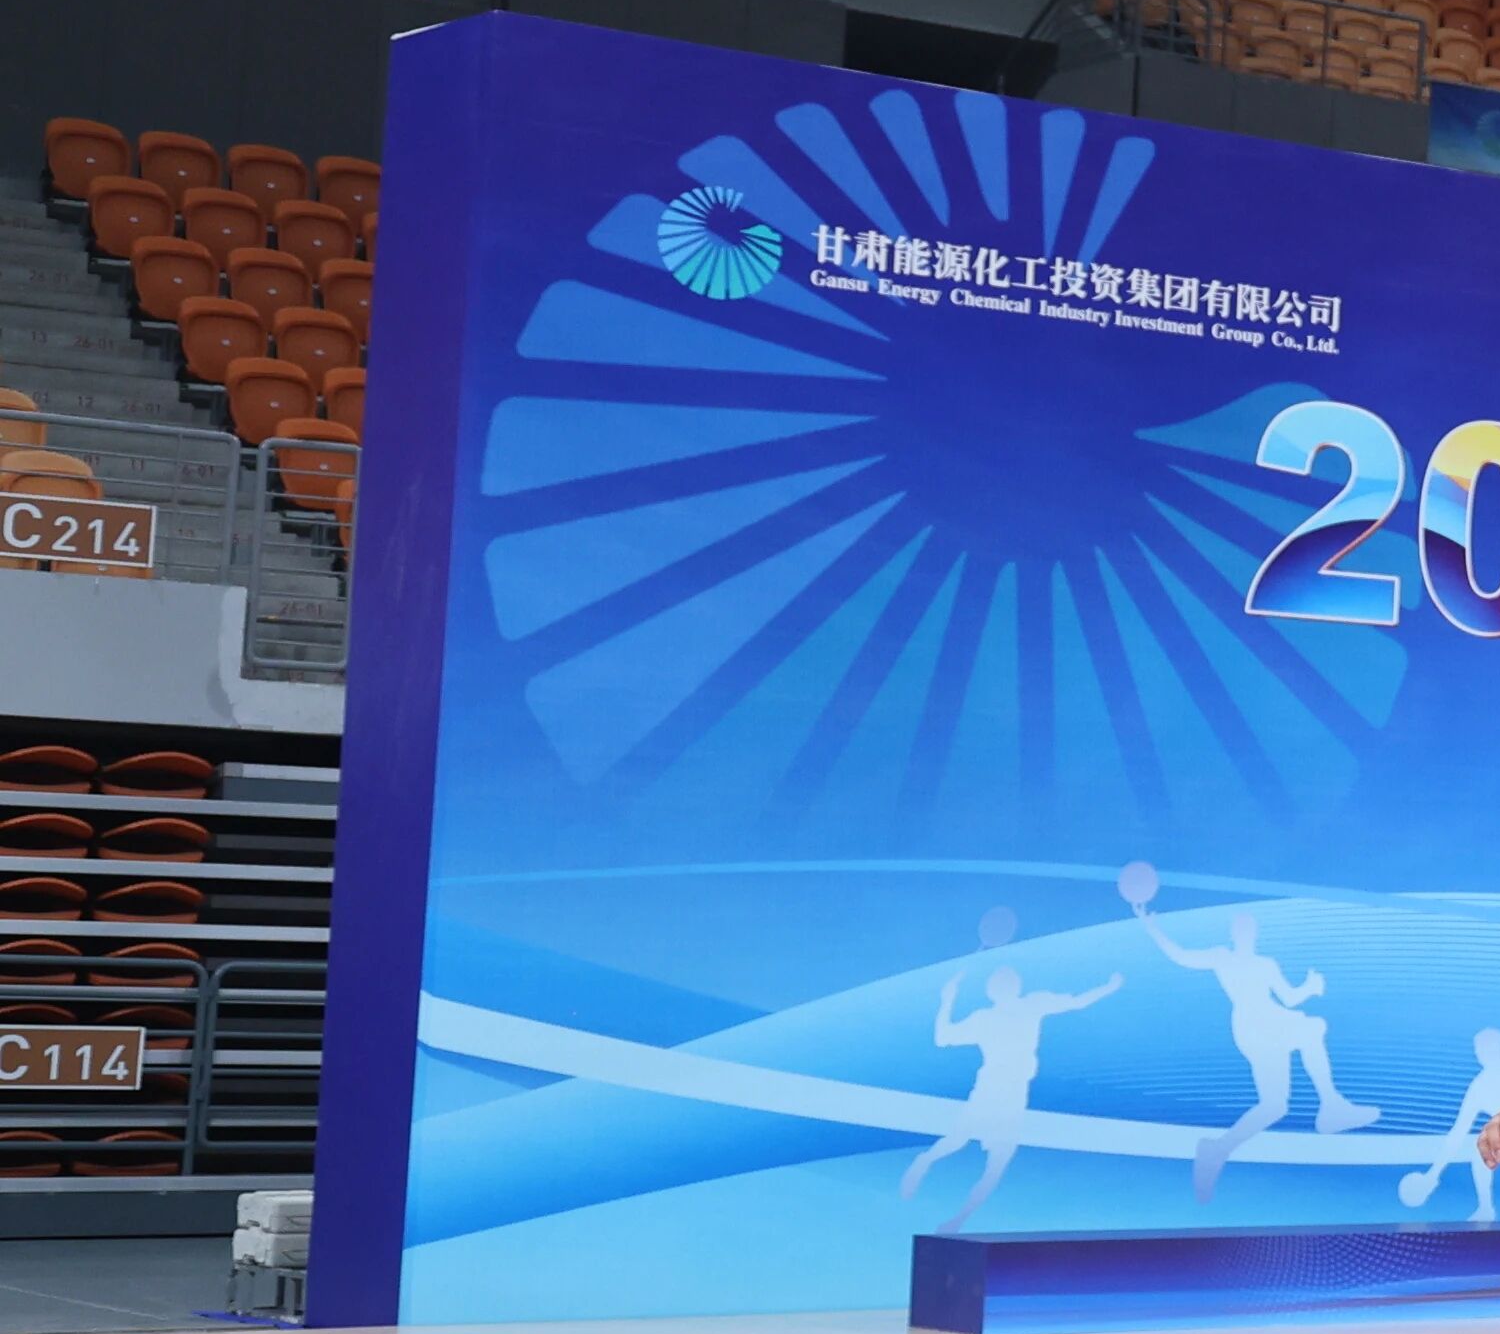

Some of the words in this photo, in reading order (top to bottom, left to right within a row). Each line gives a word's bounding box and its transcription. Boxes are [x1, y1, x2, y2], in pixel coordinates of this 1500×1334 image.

[809, 269, 870, 294] Gansu
[877, 281, 941, 306] Energy
[949, 288, 1032, 317] Chemical
[1038, 300, 1111, 327] Industry
[1113, 309, 1205, 338] Investment
[1210, 322, 1265, 347] Group
[810, 223, 1343, 333] 甘肃能源化工投资集团有限公司
[2, 503, 141, 557] C214
[0, 1033, 130, 1080] C114
